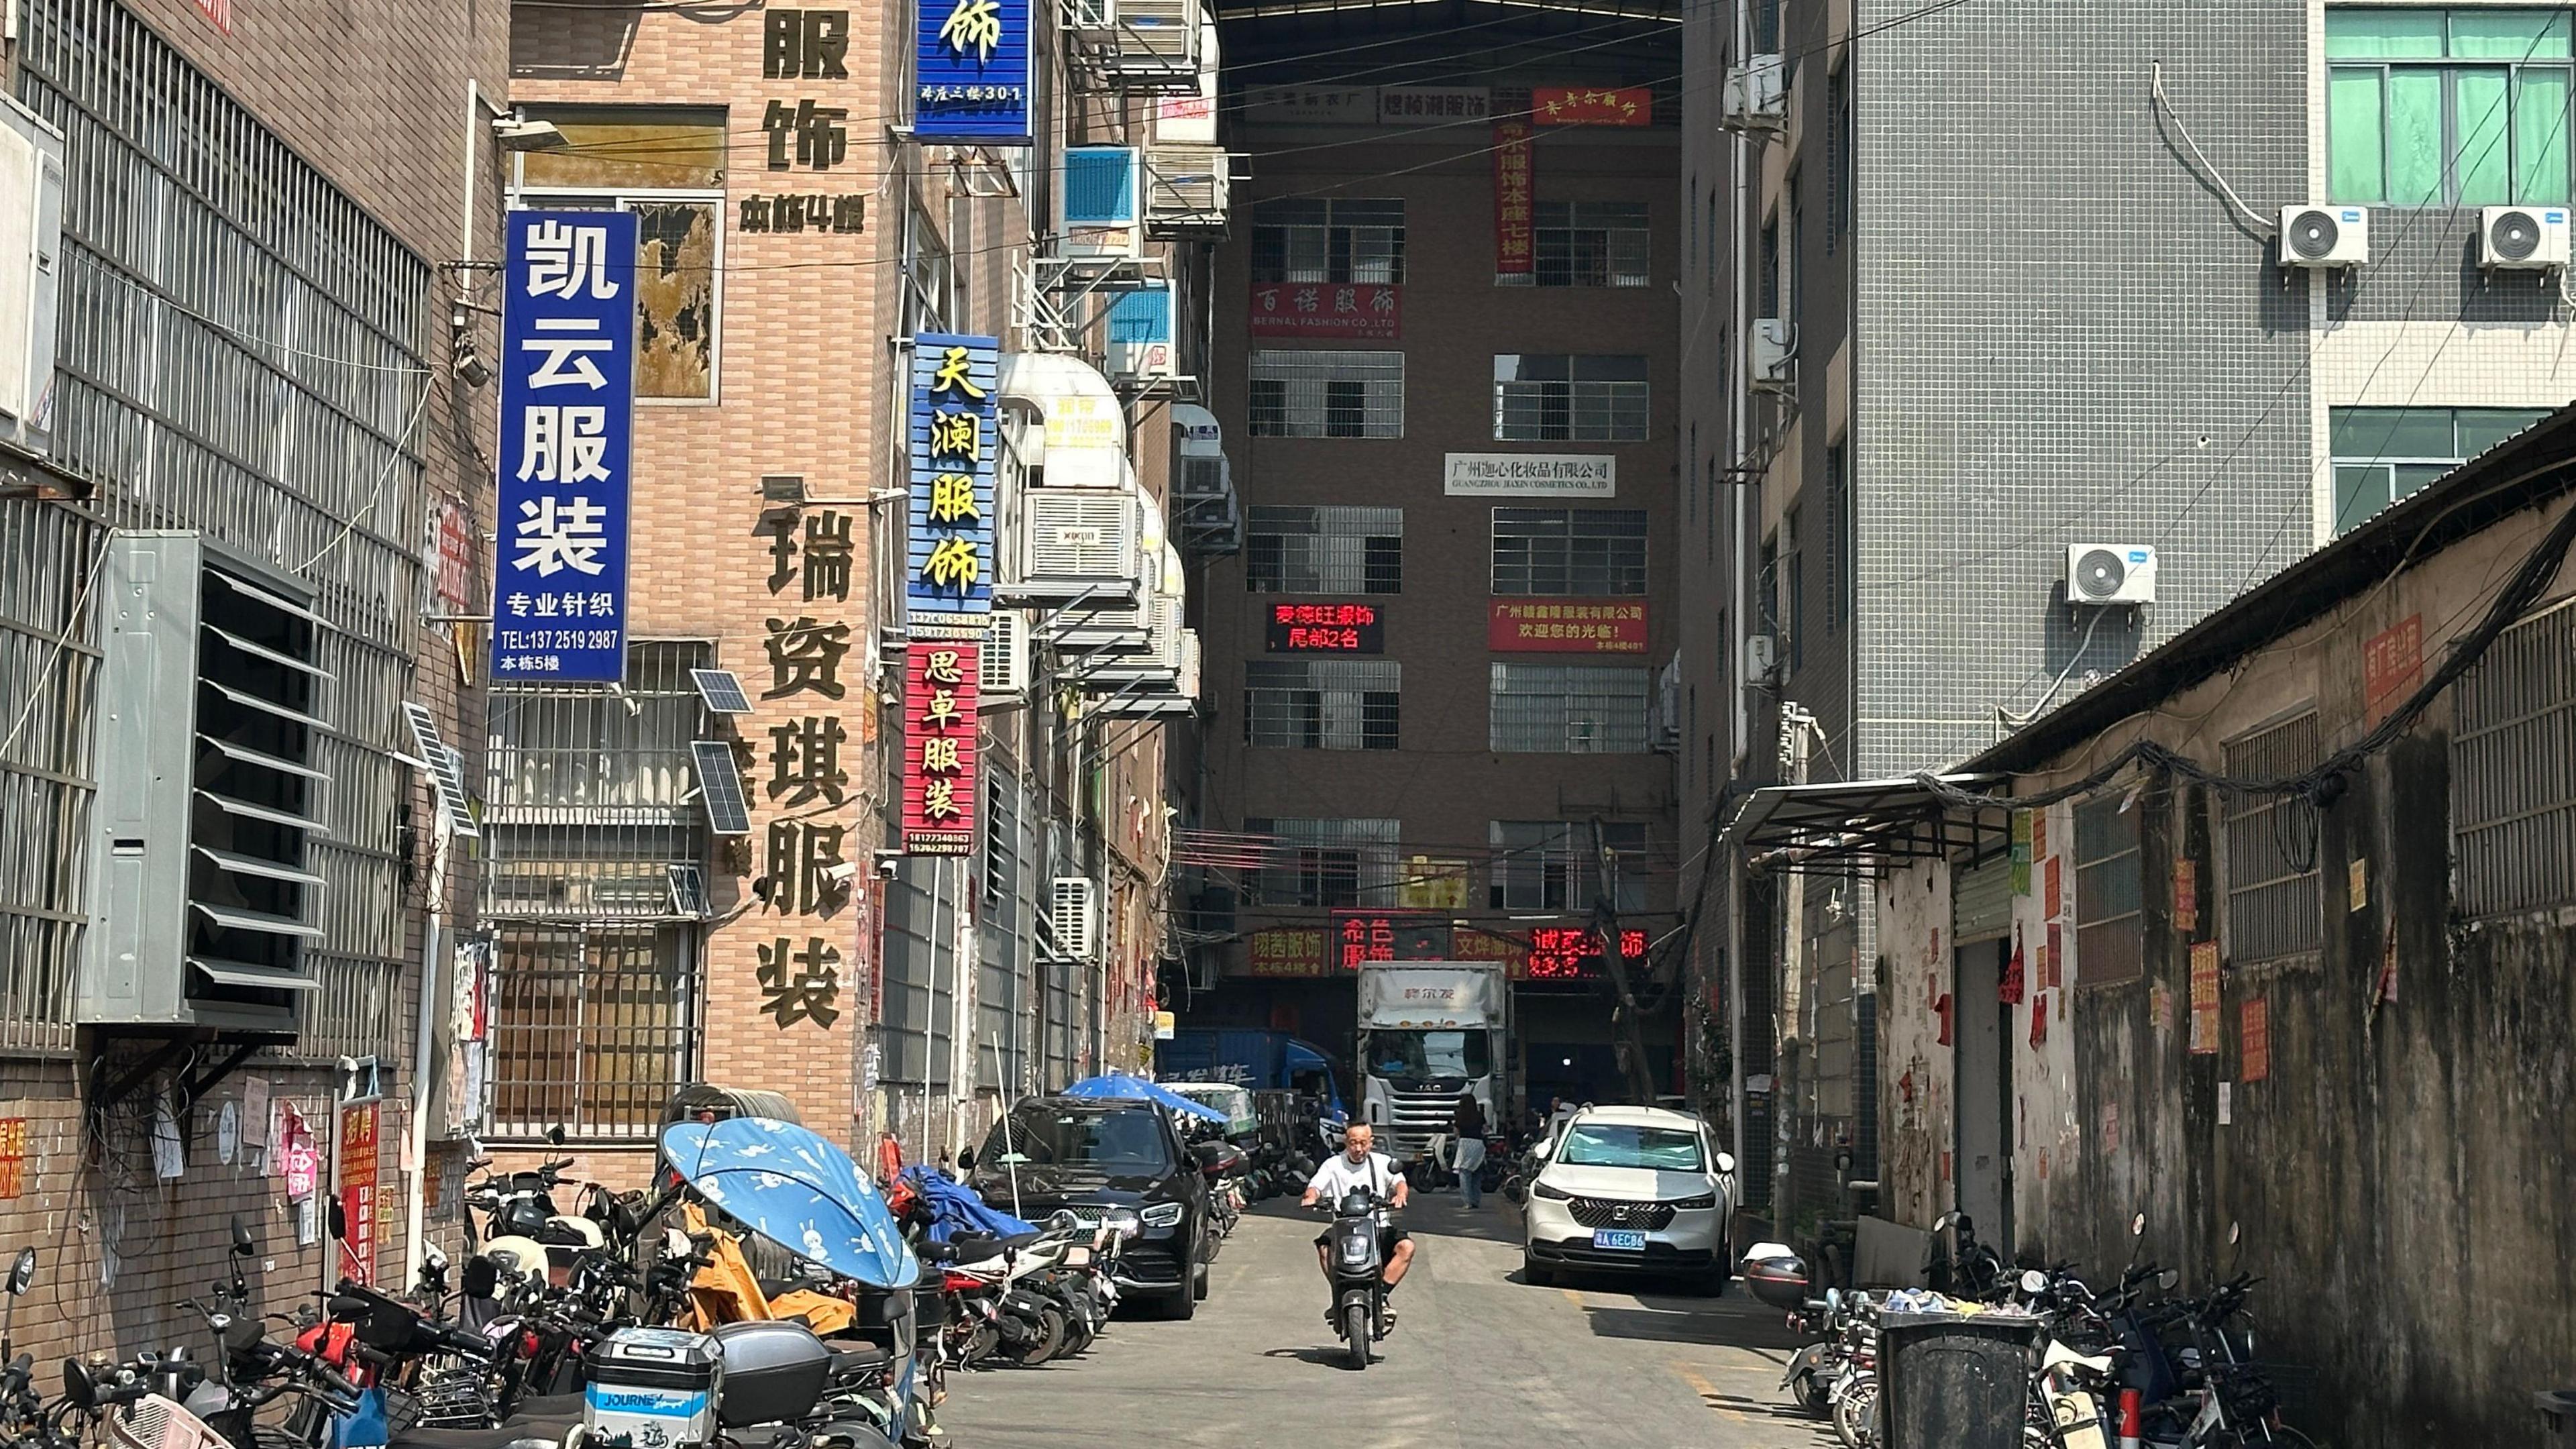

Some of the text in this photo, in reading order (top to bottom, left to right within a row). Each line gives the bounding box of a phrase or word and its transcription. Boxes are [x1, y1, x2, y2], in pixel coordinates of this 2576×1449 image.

[763, 10, 849, 171] 服饰
[1256, 287, 1395, 317] 百诺服饰
[1300, 317, 1350, 327] FASHION
[511, 220, 619, 578] 凯云服装
[924, 346, 987, 597] 天澜服饰
[1452, 479, 1501, 488] GUANGZHOU
[1529, 480, 1574, 488] COSMETICS
[506, 591, 615, 618] 专业针织
[501, 629, 618, 651] TEL:137 2519 2987
[1289, 628, 1358, 648] 尾部2名
[500, 655, 560, 672] 本栋5楼
[922, 649, 964, 820] 思卓服装
[756, 508, 855, 1031] 瑞资琪服装
[1415, 1083, 1442, 1092] JAC
